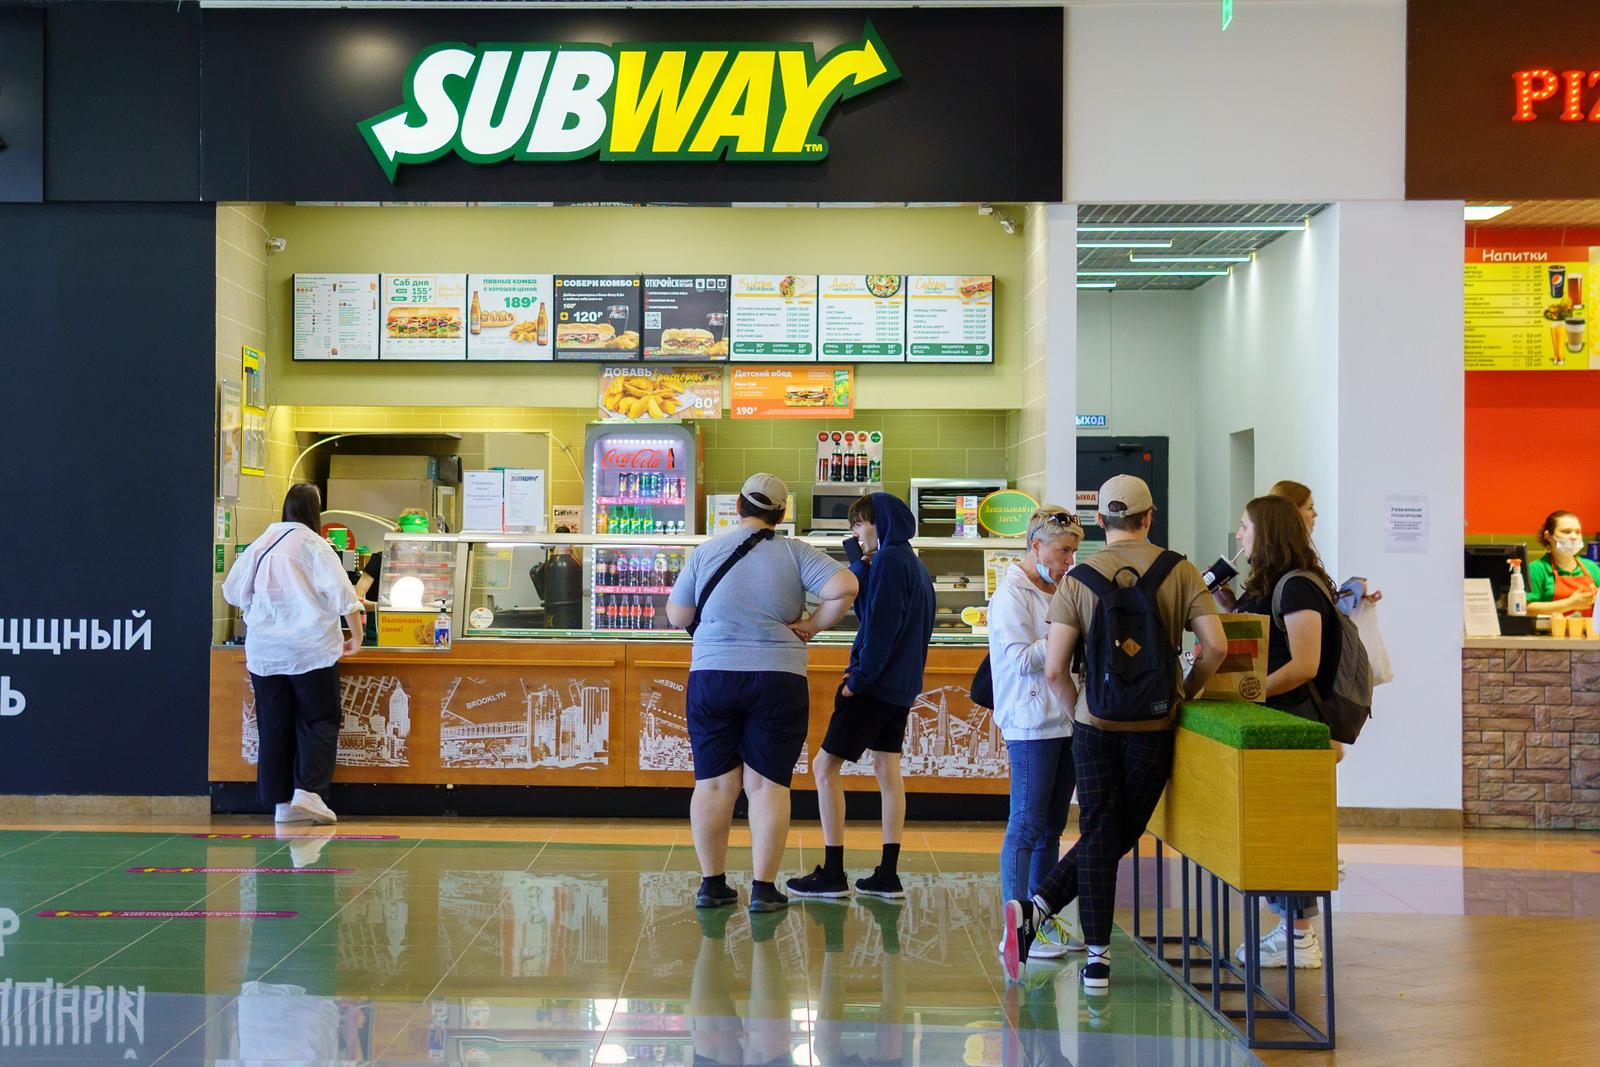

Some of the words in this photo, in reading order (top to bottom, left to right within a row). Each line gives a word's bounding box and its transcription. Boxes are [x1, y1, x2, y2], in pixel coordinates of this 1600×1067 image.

[371, 39, 887, 161] SUBWAY
[1482, 249, 1548, 262] Напитки
[645, 277, 678, 288] ОТКРОЙСЯ
[604, 368, 652, 378] ДОБАВЬ
[735, 370, 769, 378] Детский
[771, 370, 792, 378] обед
[1076, 415, 1105, 426] ЫХОД
[601, 448, 663, 469] Coca-Cola
[1076, 494, 1096, 502] ЫХОД
[381, 616, 422, 624] Выпекаем
[466, 691, 507, 709] BROOKLYN
